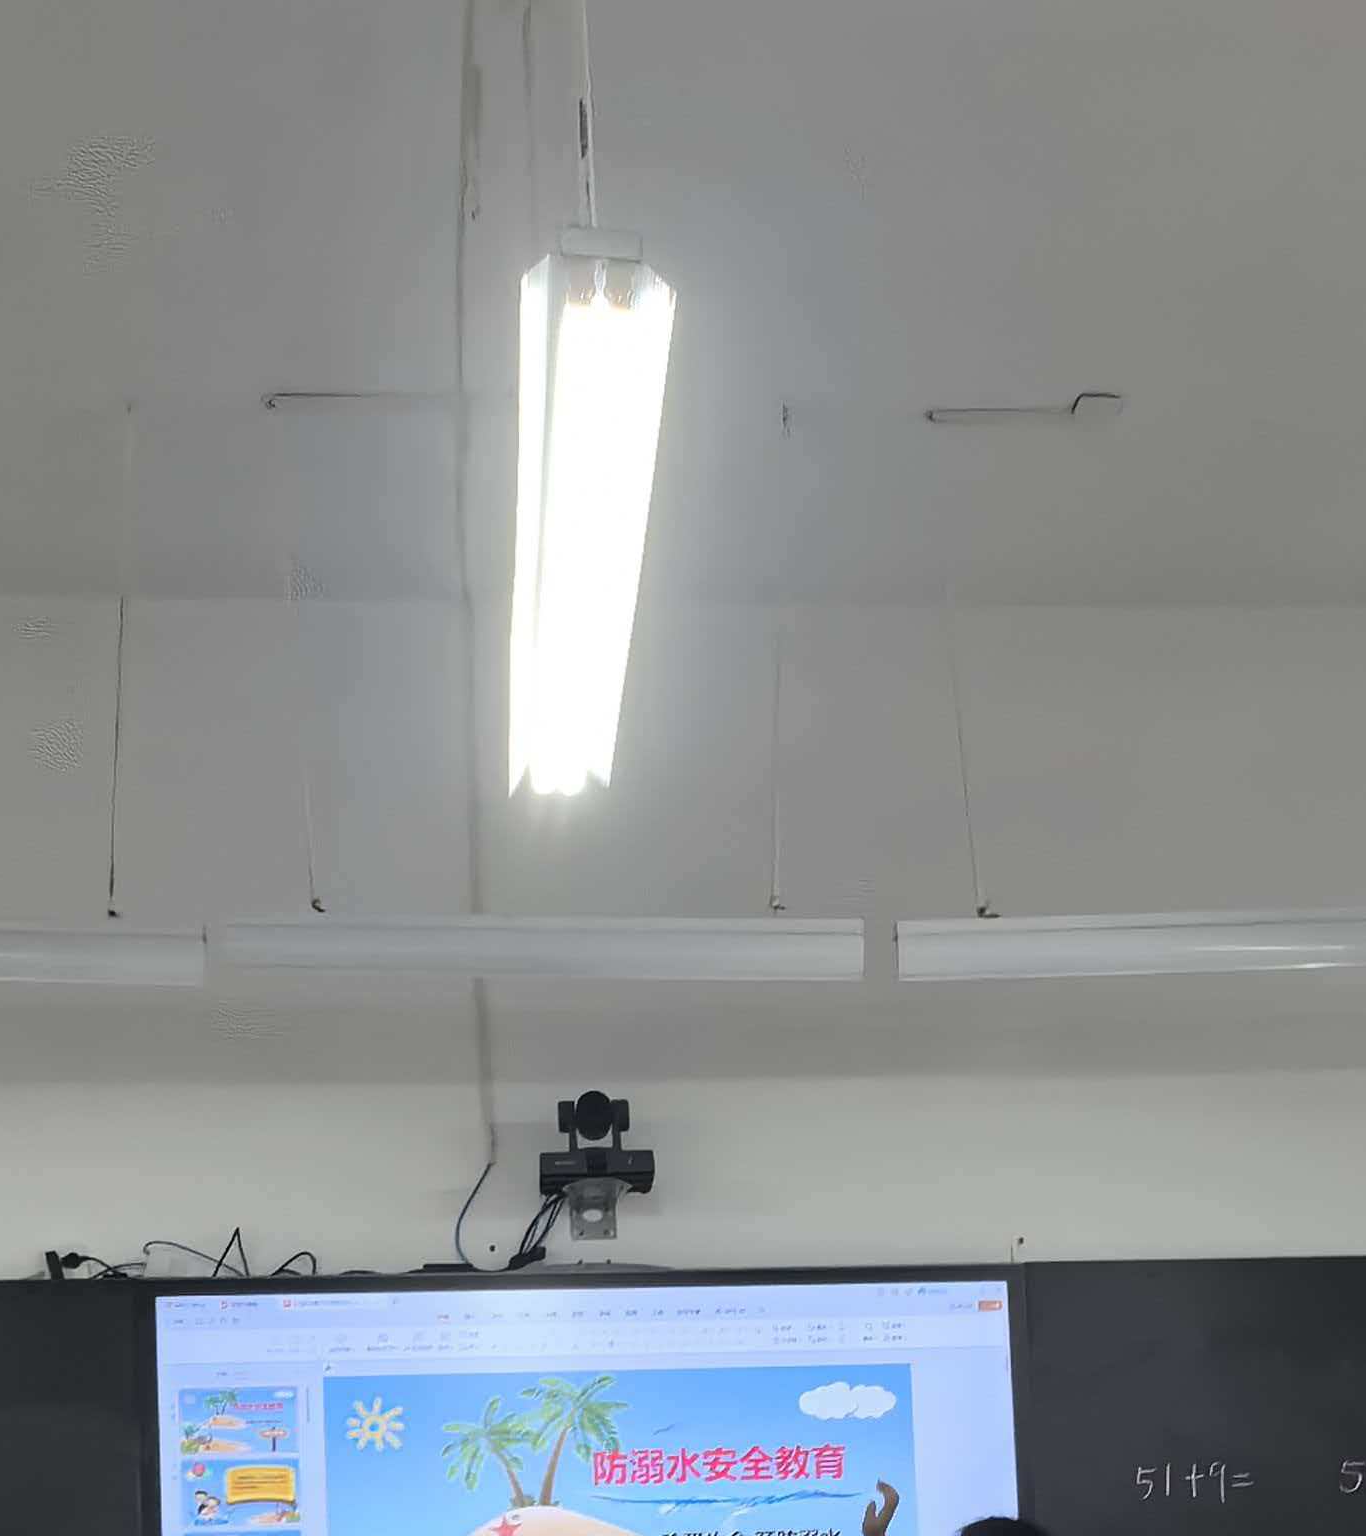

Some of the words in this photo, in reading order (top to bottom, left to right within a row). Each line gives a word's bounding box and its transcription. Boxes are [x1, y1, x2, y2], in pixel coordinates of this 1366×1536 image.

[594, 1443, 846, 1487] 防溺水安全教育
[1136, 1461, 1254, 1504] 51+9=
